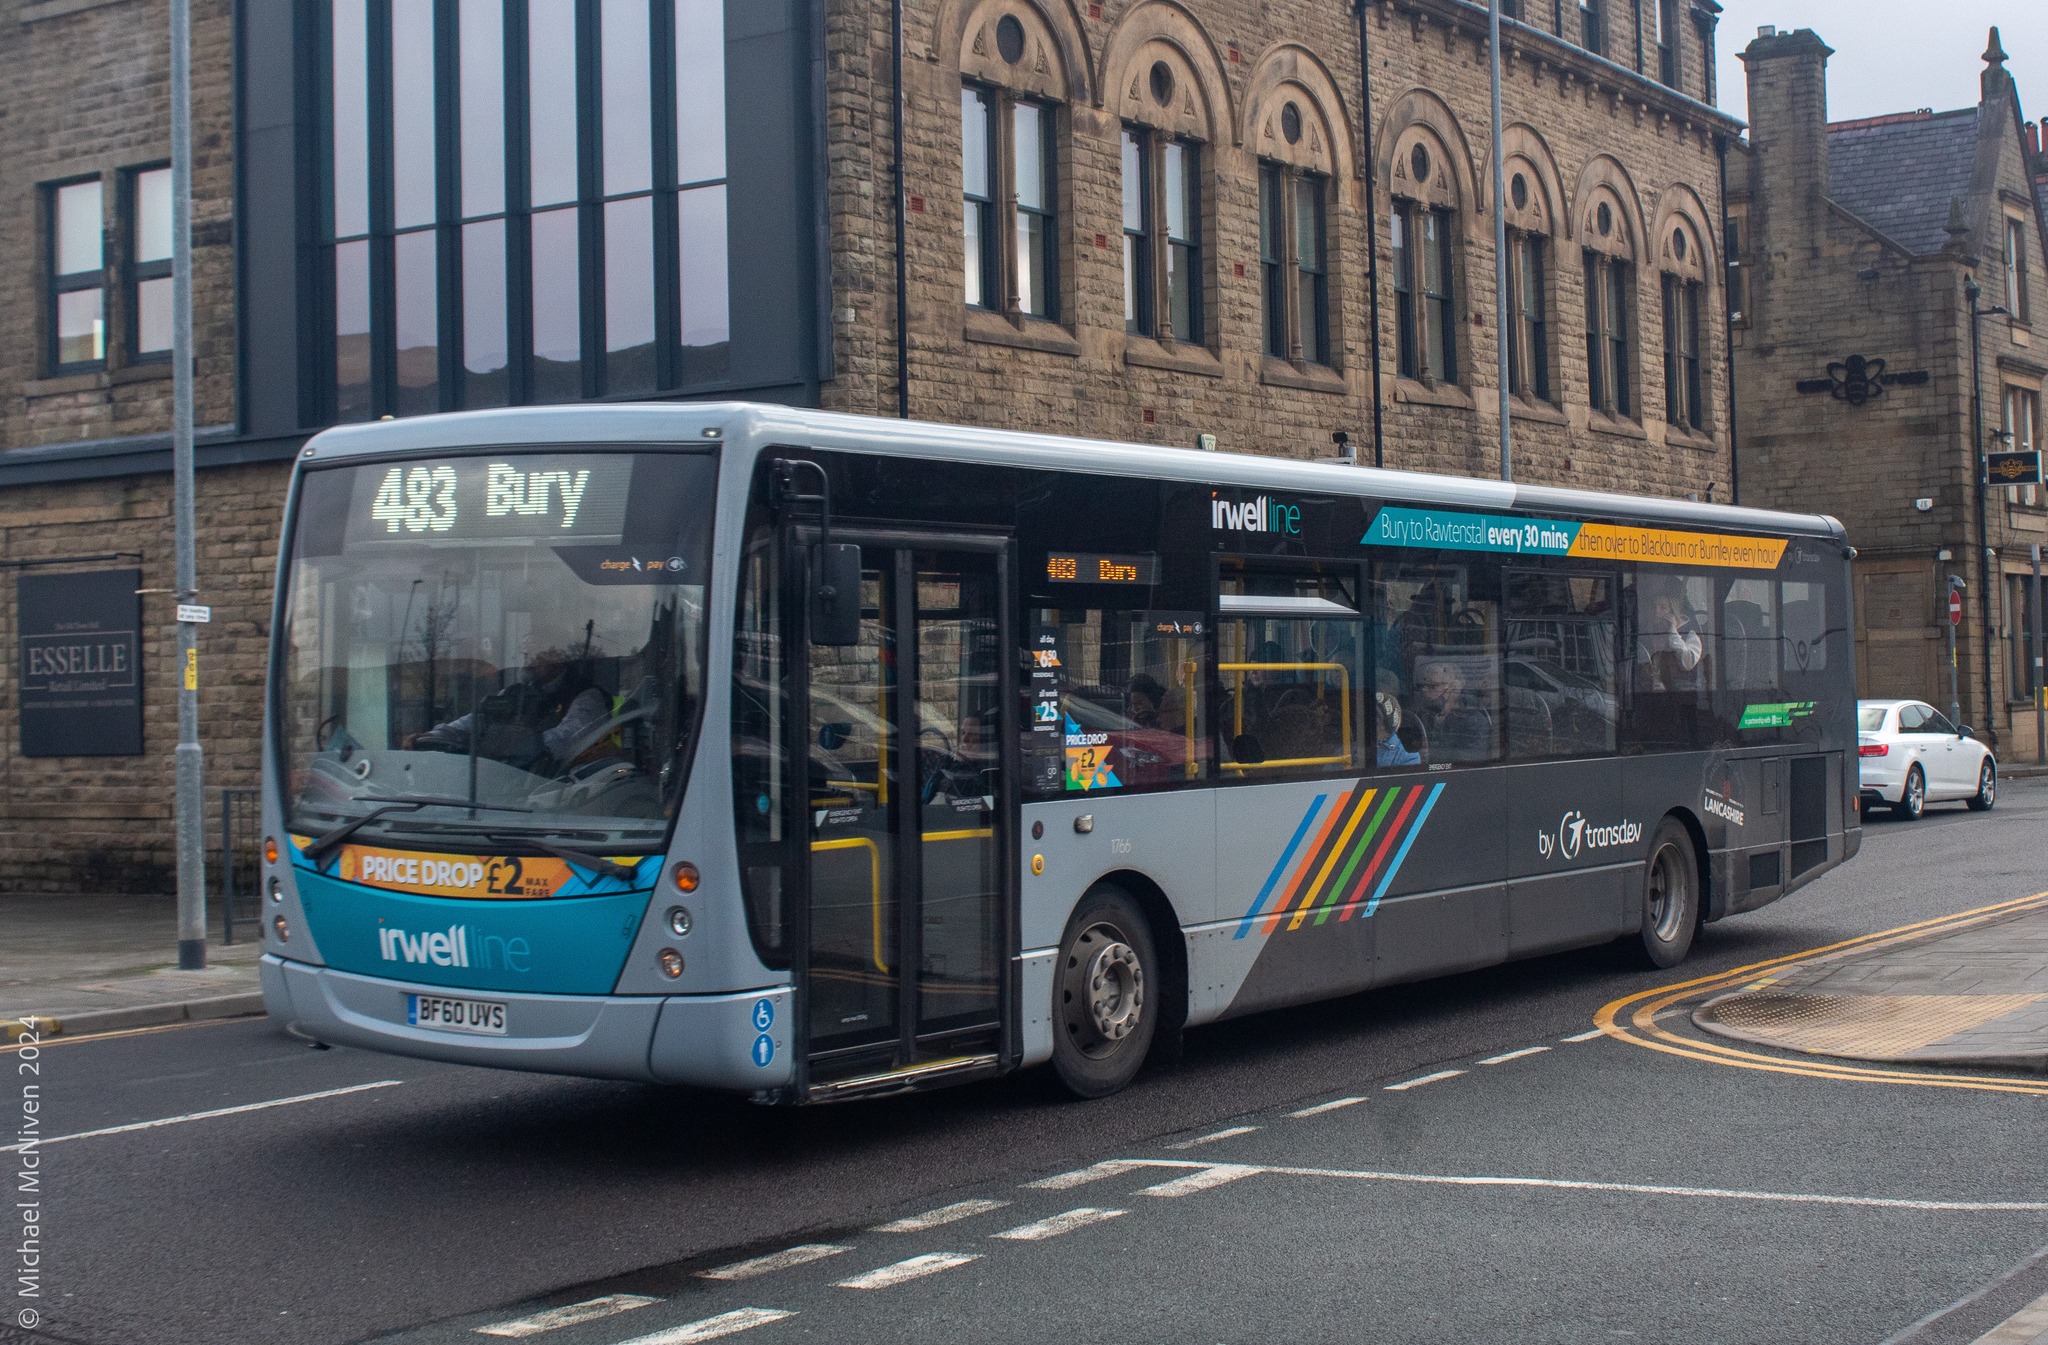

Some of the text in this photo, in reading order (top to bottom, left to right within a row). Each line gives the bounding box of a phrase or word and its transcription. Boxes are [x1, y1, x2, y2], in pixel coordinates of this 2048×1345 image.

[371, 463, 591, 532] 483 Bury
[1381, 513, 1569, 553] Bury to Rawtenstall every 30 mins
[1579, 526, 1777, 567] then over to Blackburn or Burnley every hour
[600, 559, 665, 572] charge pay
[1046, 558, 1136, 580] 483 Bury
[29, 644, 127, 676] ESSELLE
[1065, 733, 1108, 746] PRICE DROP
[1081, 748, 1096, 768] £2
[1704, 796, 1744, 826] LANCASHIRE
[1111, 838, 1131, 854] 1766
[1538, 818, 1642, 860] by transdev
[362, 855, 525, 895] PRICE DROP £2
[526, 877, 549, 887] MAX
[526, 888, 550, 898] FARE
[420, 998, 504, 1029] BF60 UVS
